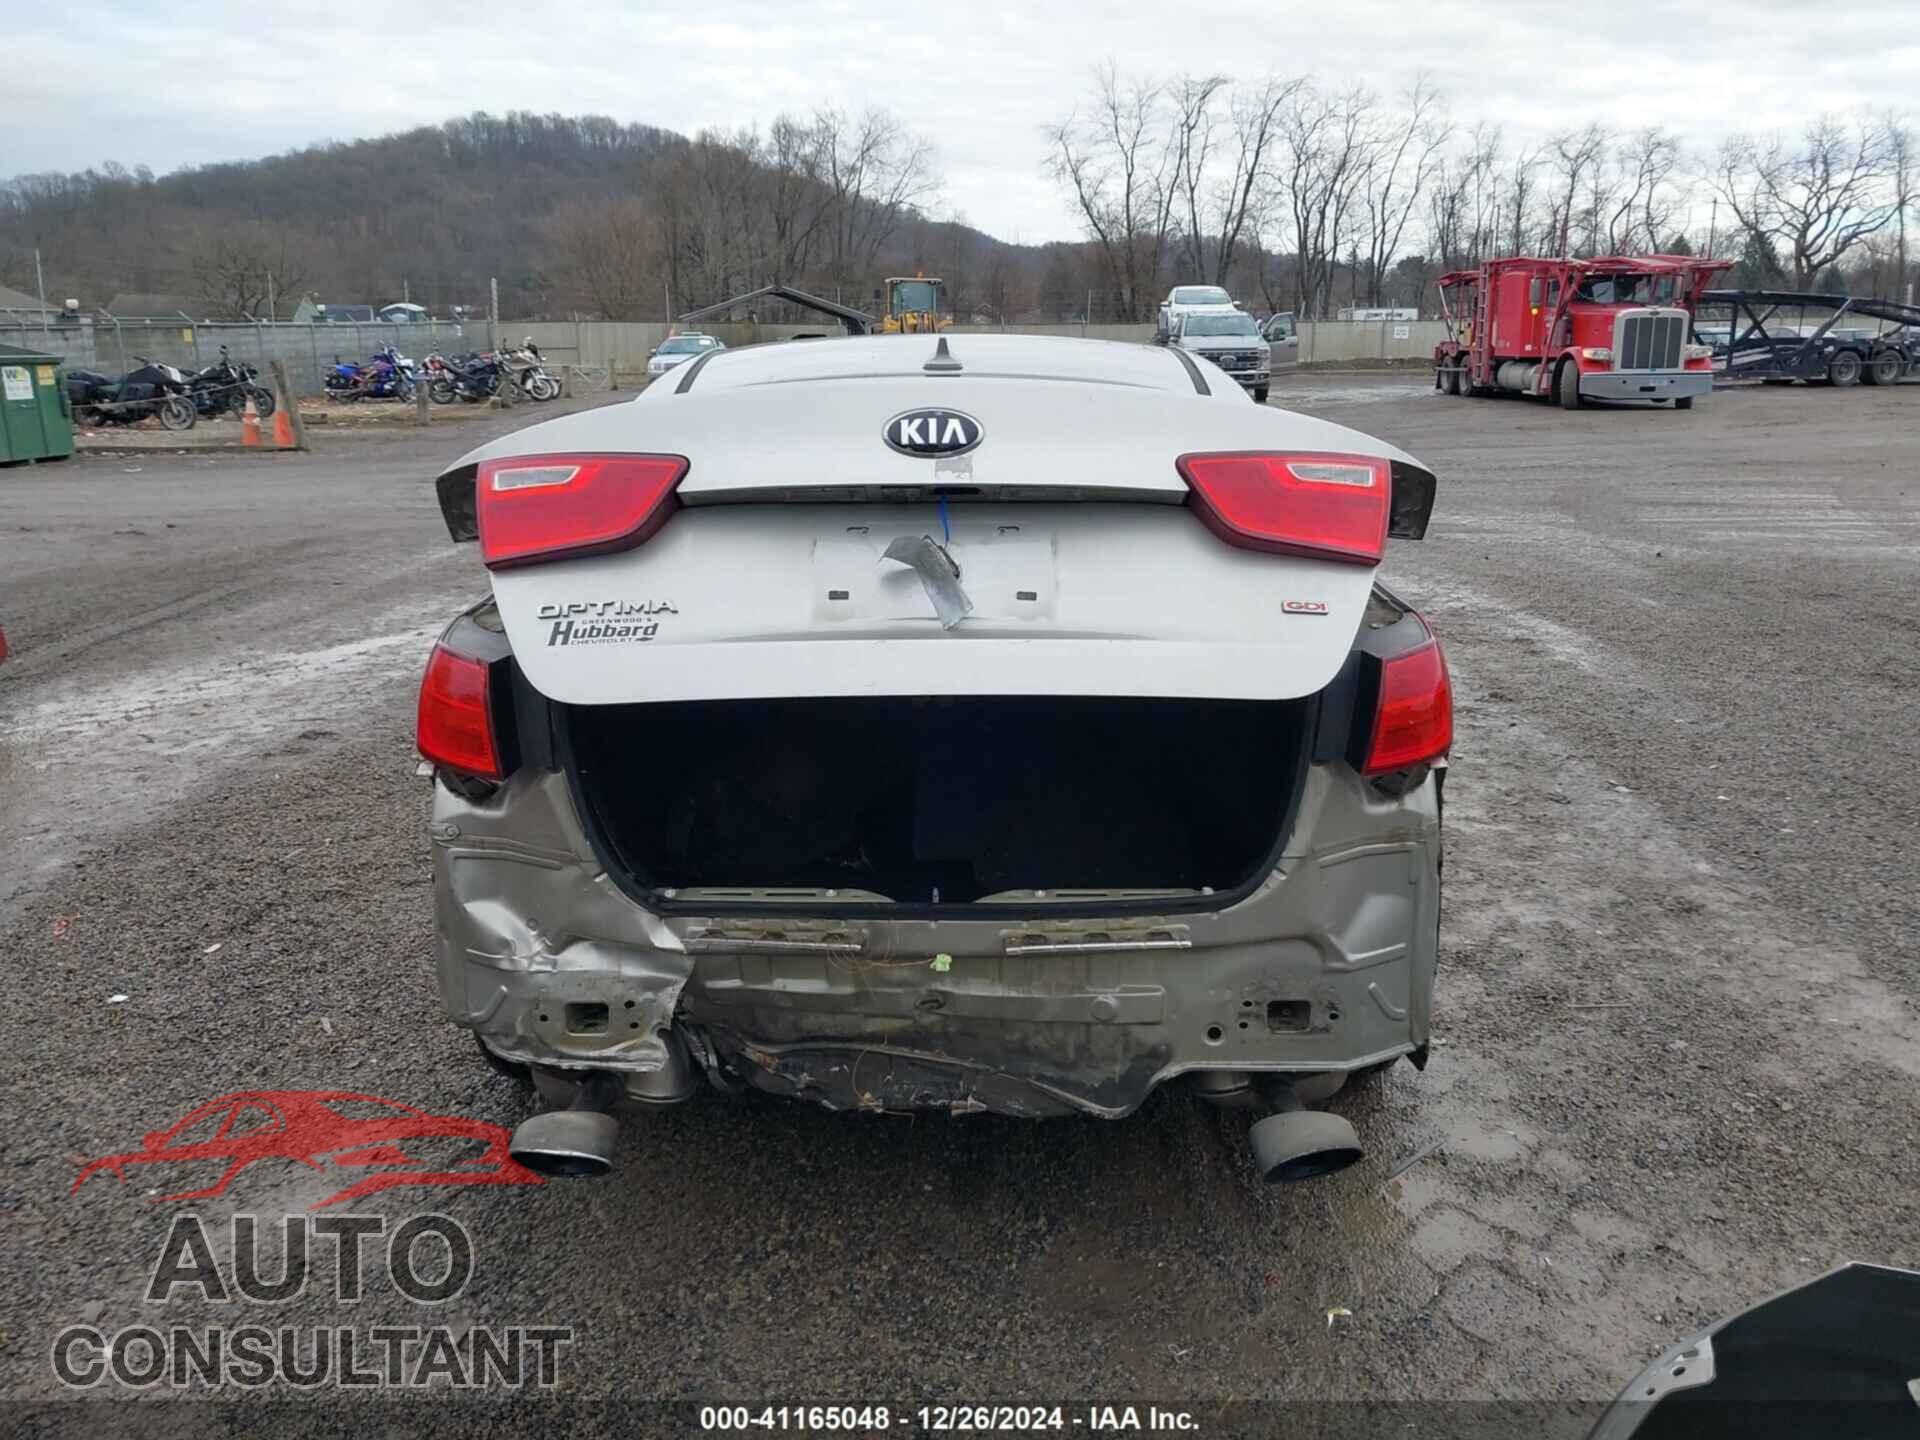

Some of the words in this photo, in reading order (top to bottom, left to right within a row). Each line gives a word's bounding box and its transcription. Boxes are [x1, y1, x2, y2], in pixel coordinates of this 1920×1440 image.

[900, 417, 967, 445] KIA
[537, 599, 679, 620] OPTIMA
[547, 620, 659, 646] Hubbard
